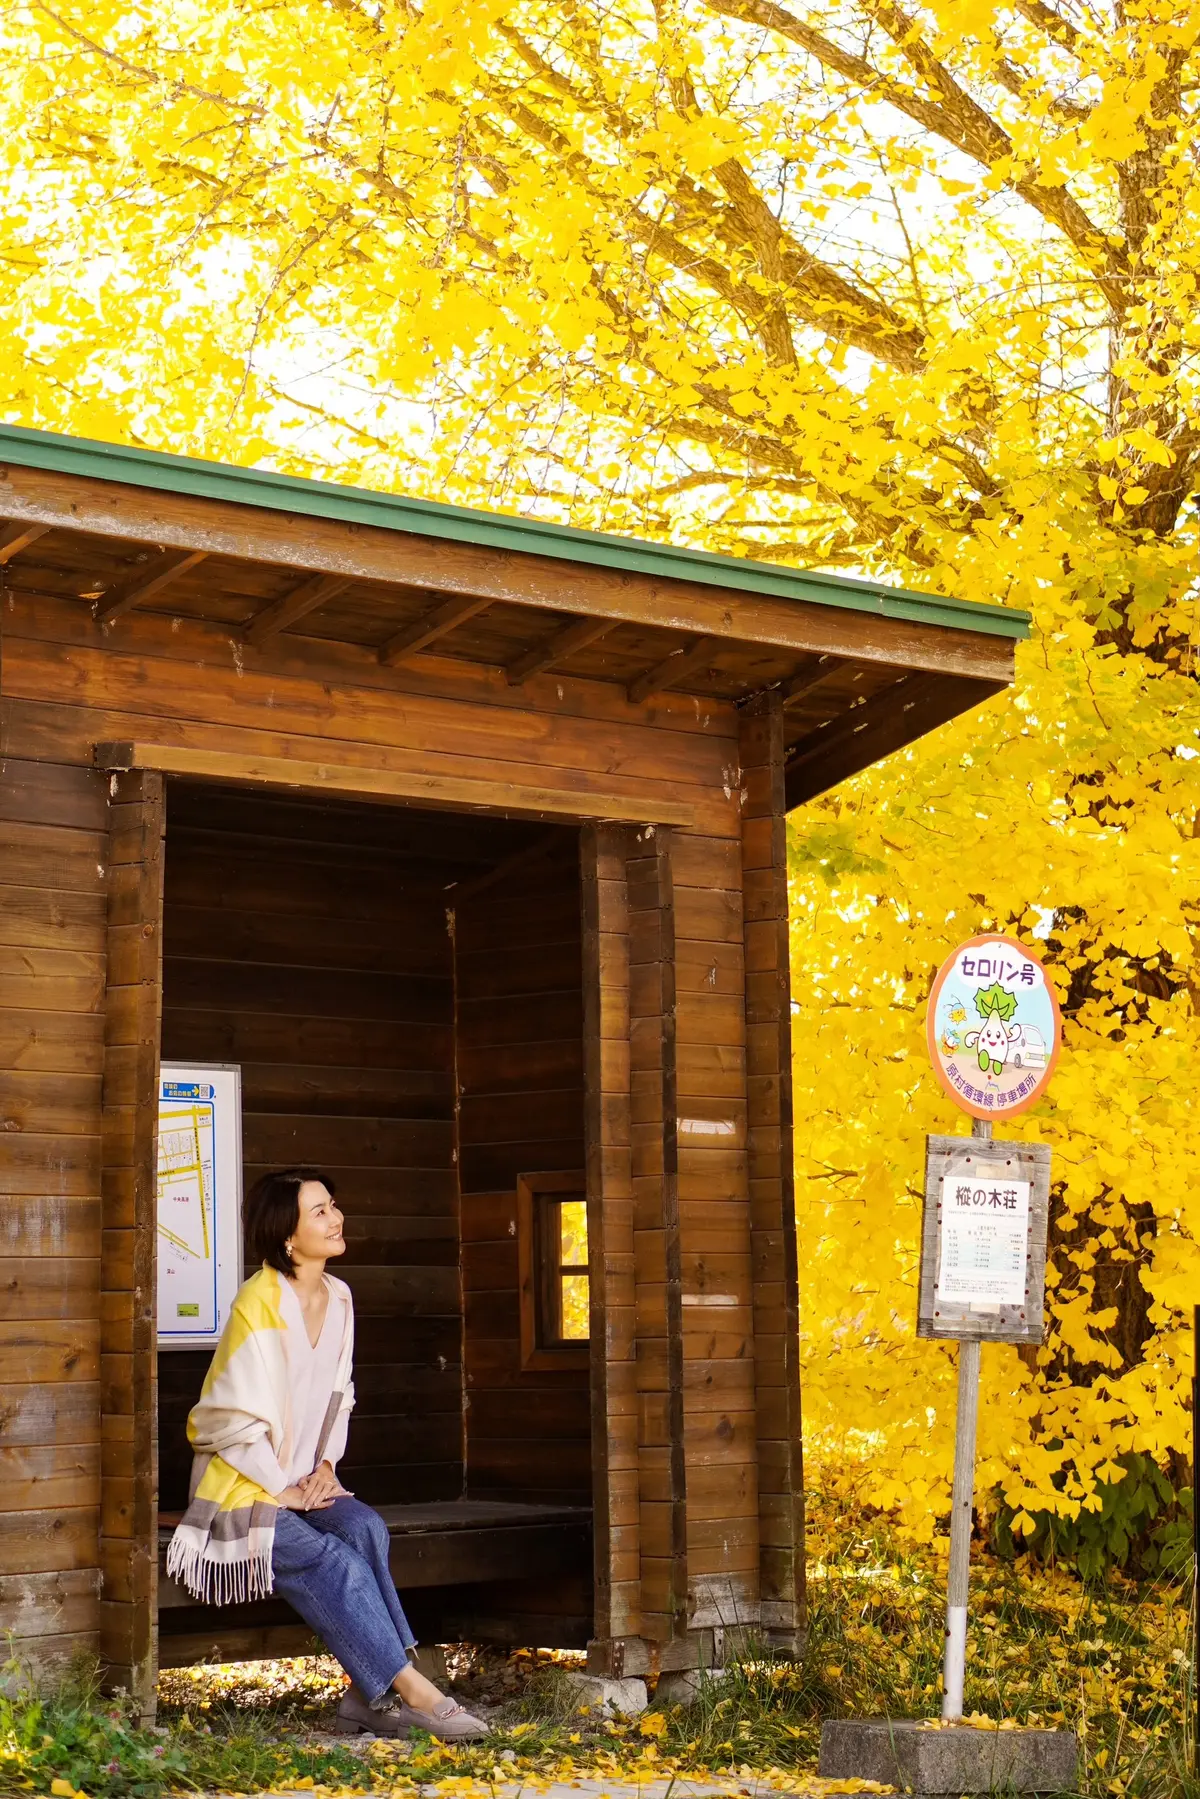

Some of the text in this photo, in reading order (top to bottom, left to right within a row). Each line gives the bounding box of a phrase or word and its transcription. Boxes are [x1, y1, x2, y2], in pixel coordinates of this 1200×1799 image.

[961, 956, 1035, 985] セロリン号
